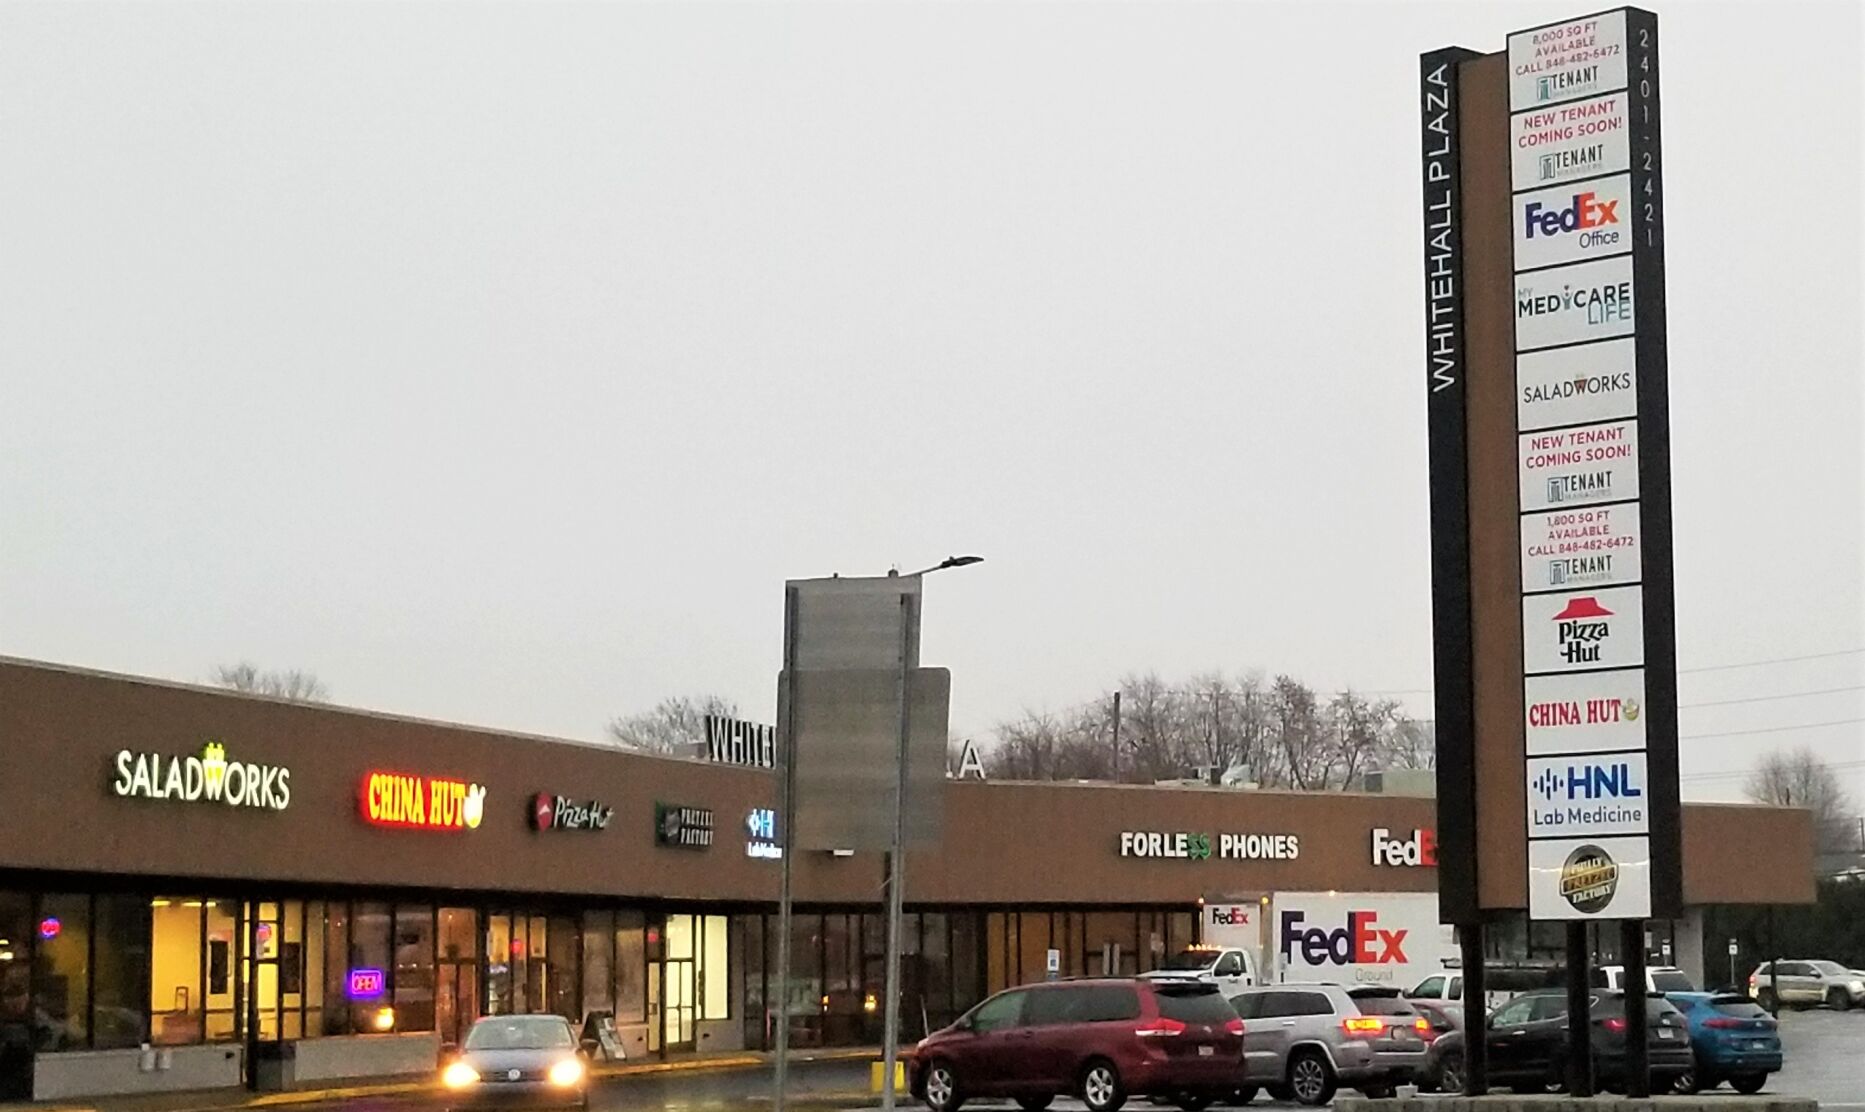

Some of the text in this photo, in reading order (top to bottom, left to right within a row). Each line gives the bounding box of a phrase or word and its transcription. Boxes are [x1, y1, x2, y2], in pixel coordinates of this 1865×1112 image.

[1533, 21, 1597, 45] 8,000 SQ FT
[1535, 35, 1595, 58] AVAILABLE
[1515, 44, 1620, 76] CALL 848-482-6472
[1552, 65, 1598, 89] TENANT
[1524, 100, 1616, 129] NEW TENANT
[1518, 117, 1622, 148] COMING SOON!
[1556, 144, 1603, 169] TENANT
[1427, 63, 1455, 393] WHITEHALL PLAZA
[1525, 192, 1619, 239] FedEx
[1579, 231, 1619, 249] Office
[1588, 300, 1631, 325] LIFE
[1523, 372, 1631, 404] SALADWORKS
[1531, 427, 1625, 451] NEW TENANT
[1526, 444, 1631, 469] COMING SOON!
[1564, 471, 1612, 492] TENANT
[1578, 513, 1593, 525] SQ
[1597, 510, 1609, 521] FT
[1549, 524, 1609, 540] AVAILABLE
[1528, 536, 1634, 557] CALL 848-482-6472
[1565, 555, 1612, 575] TENANT
[1559, 620, 1609, 645] Pizza
[1560, 641, 1601, 663] Hut
[1529, 699, 1621, 727] CHINA HUT
[114, 746, 291, 810] SALADWORKS
[1567, 763, 1641, 800] HNL
[369, 773, 465, 826] CHINA HUT
[553, 795, 589, 829] Pizza
[1534, 806, 1641, 825] Lab Medicine
[1220, 834, 1299, 860] PHONES
[1373, 828, 1438, 866] FedE
[1212, 907, 1248, 925] FedEx
[1281, 911, 1408, 966] FedEx
[354, 975, 379, 990] OPEN
[1355, 968, 1393, 982] Ground
